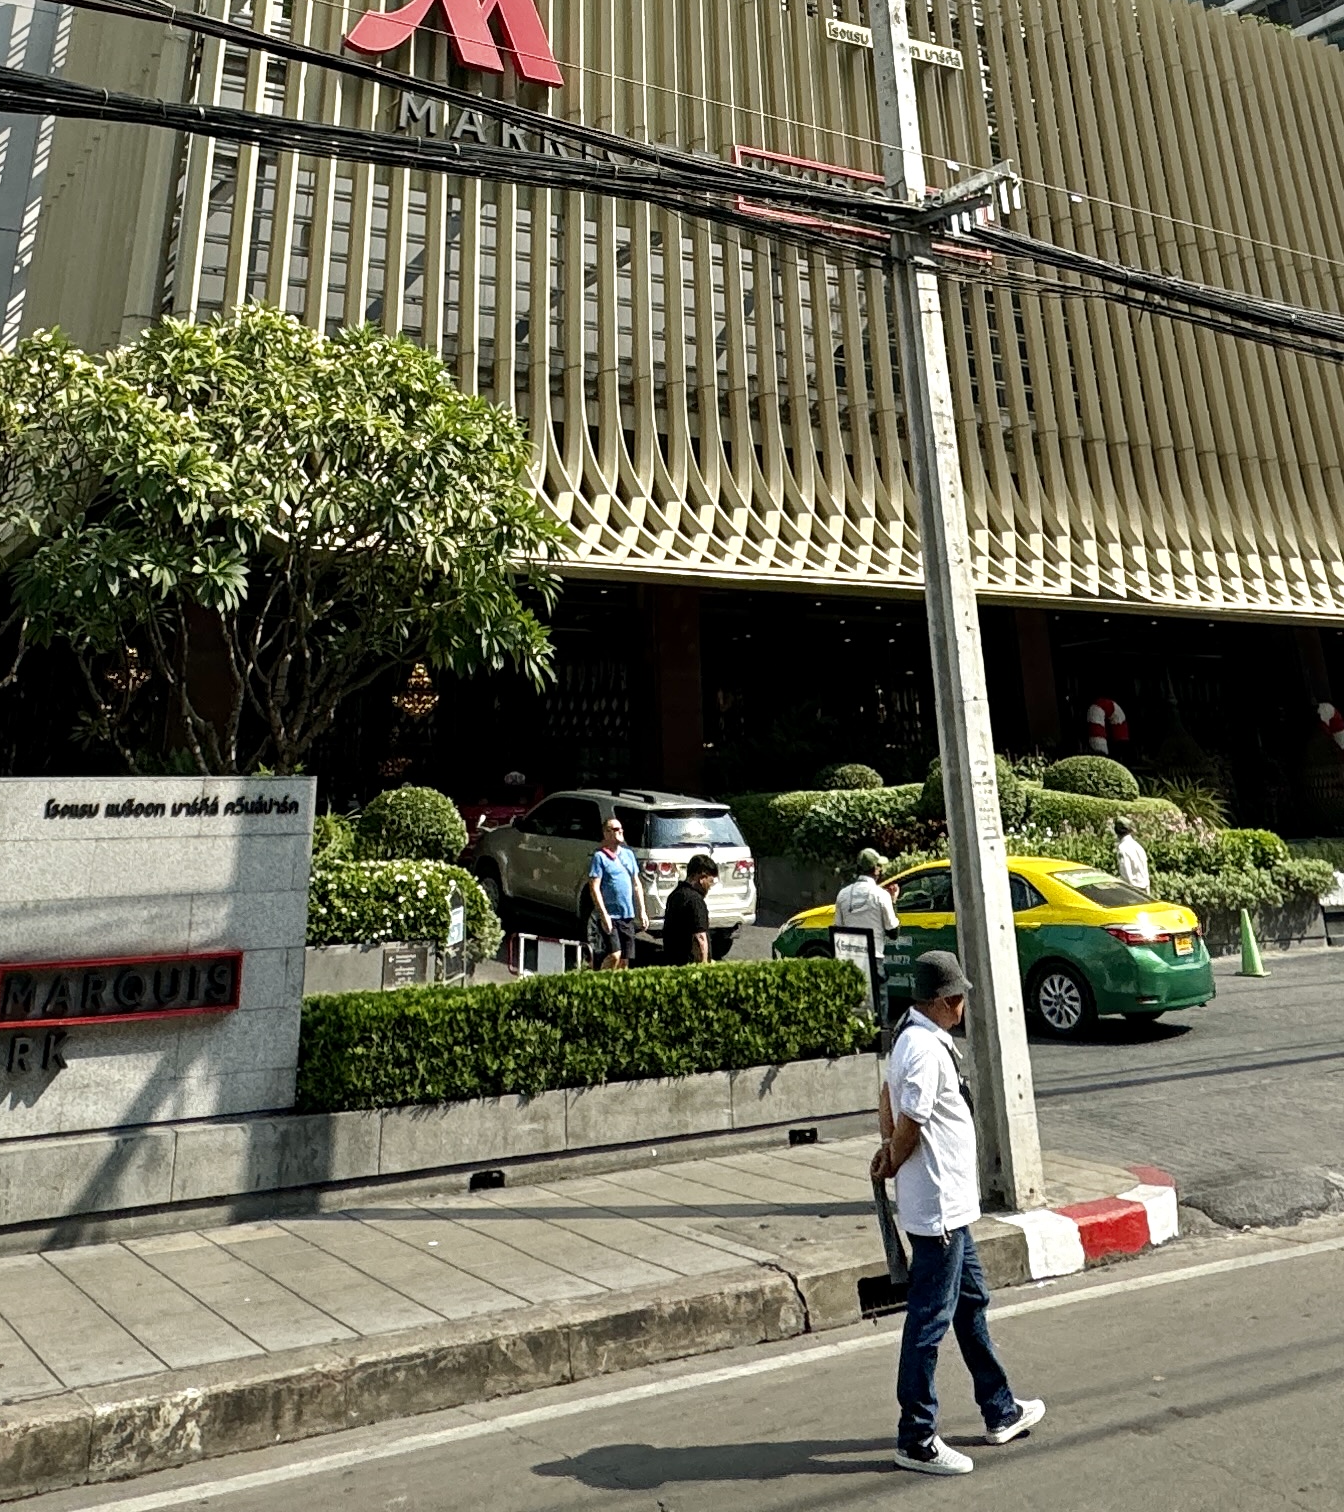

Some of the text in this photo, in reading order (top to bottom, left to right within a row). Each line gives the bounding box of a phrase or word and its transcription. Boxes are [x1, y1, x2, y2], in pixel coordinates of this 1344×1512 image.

[827, 21, 869, 45] โรงแรม
[43, 798, 100, 819] โรงแรม
[0, 963, 233, 1023] MARQUIS
